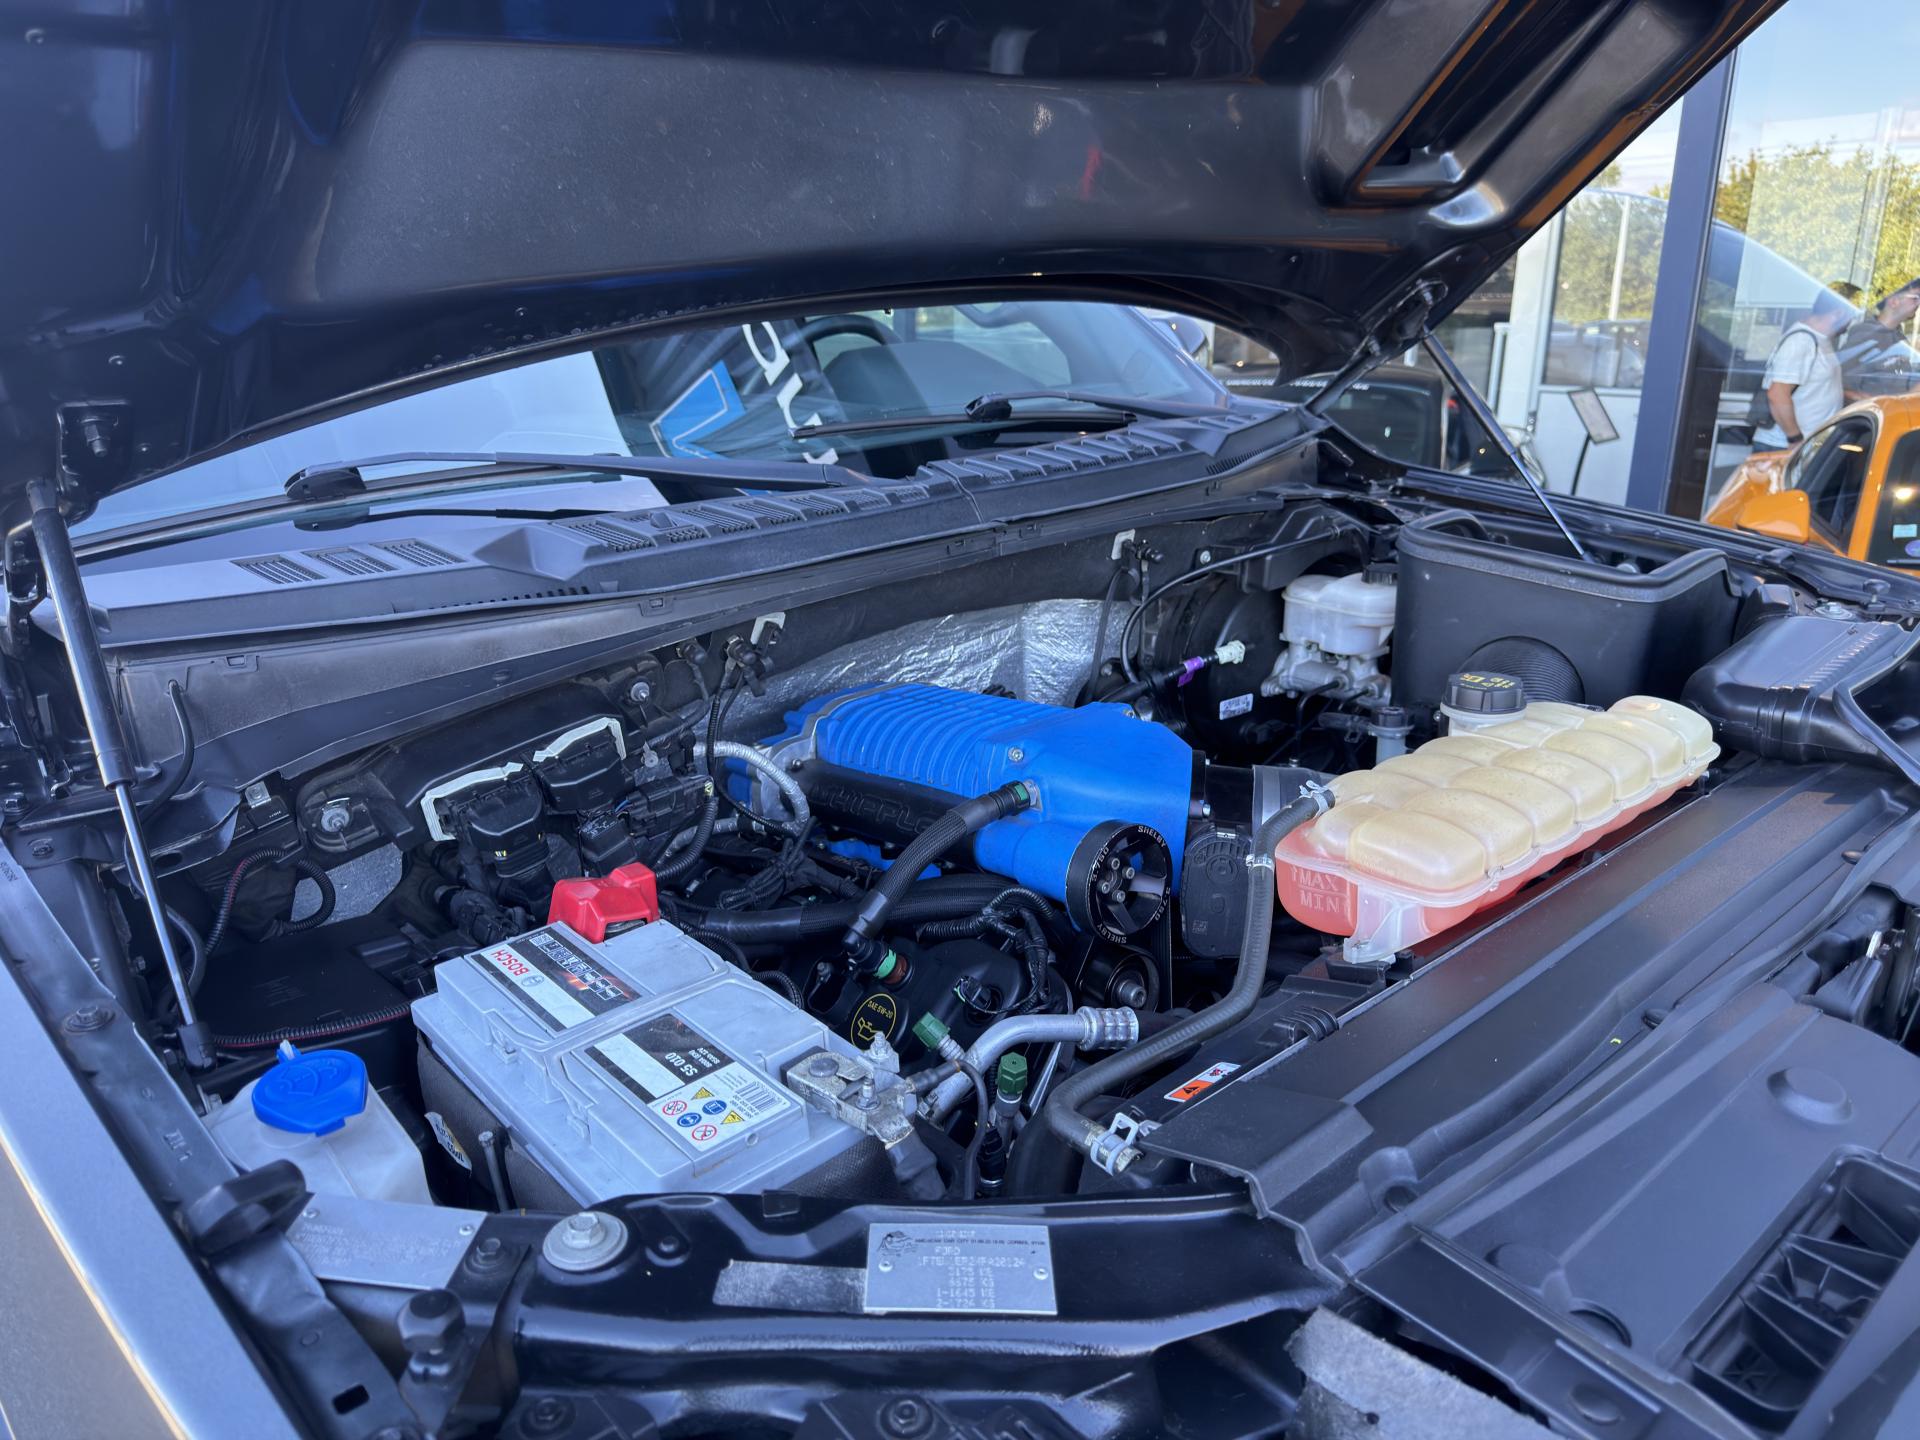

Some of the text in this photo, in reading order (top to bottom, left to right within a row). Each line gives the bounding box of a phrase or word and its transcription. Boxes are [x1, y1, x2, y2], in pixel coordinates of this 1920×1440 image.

[1137, 825, 1167, 849] SHELBY
[1300, 869, 1339, 891] MAX
[1300, 890, 1340, 913] MIN
[1096, 923, 1127, 944] SHELBY
[490, 949, 530, 976] BOSCH
[867, 1000, 894, 1019] SAE 5W-20
[665, 1051, 699, 1077] S5 010
[935, 1246, 961, 1255] FORD
